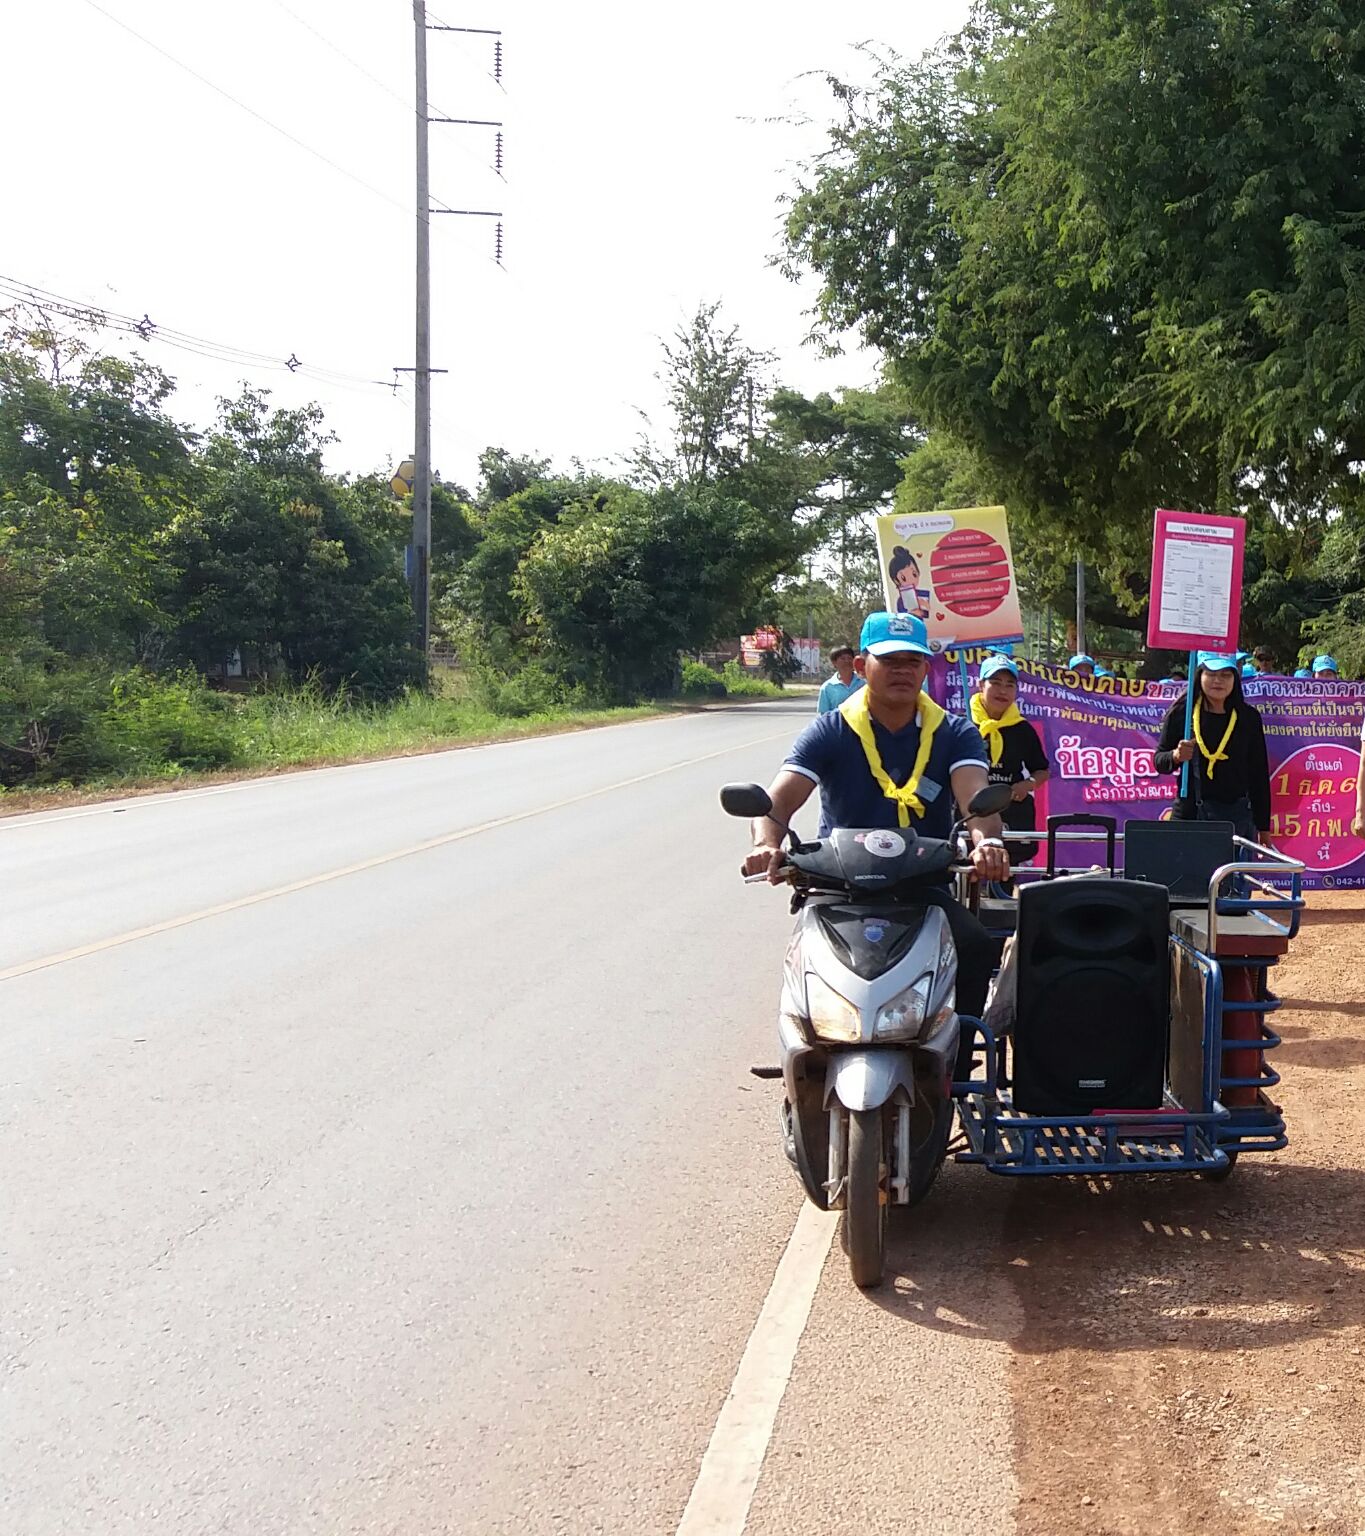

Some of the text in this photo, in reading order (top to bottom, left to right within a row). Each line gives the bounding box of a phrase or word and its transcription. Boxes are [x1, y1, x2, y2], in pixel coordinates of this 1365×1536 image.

[1018, 680, 1170, 717] นการพัฒนาประเทศด้ว
[1305, 753, 1343, 771] ตั้งแต่
[1085, 780, 1178, 800] เพื่อการพัฒน
[1275, 773, 1292, 796] 1
[1270, 814, 1301, 837] 15
[1317, 842, 1330, 860] นี้
[854, 873, 887, 881] HONDA
